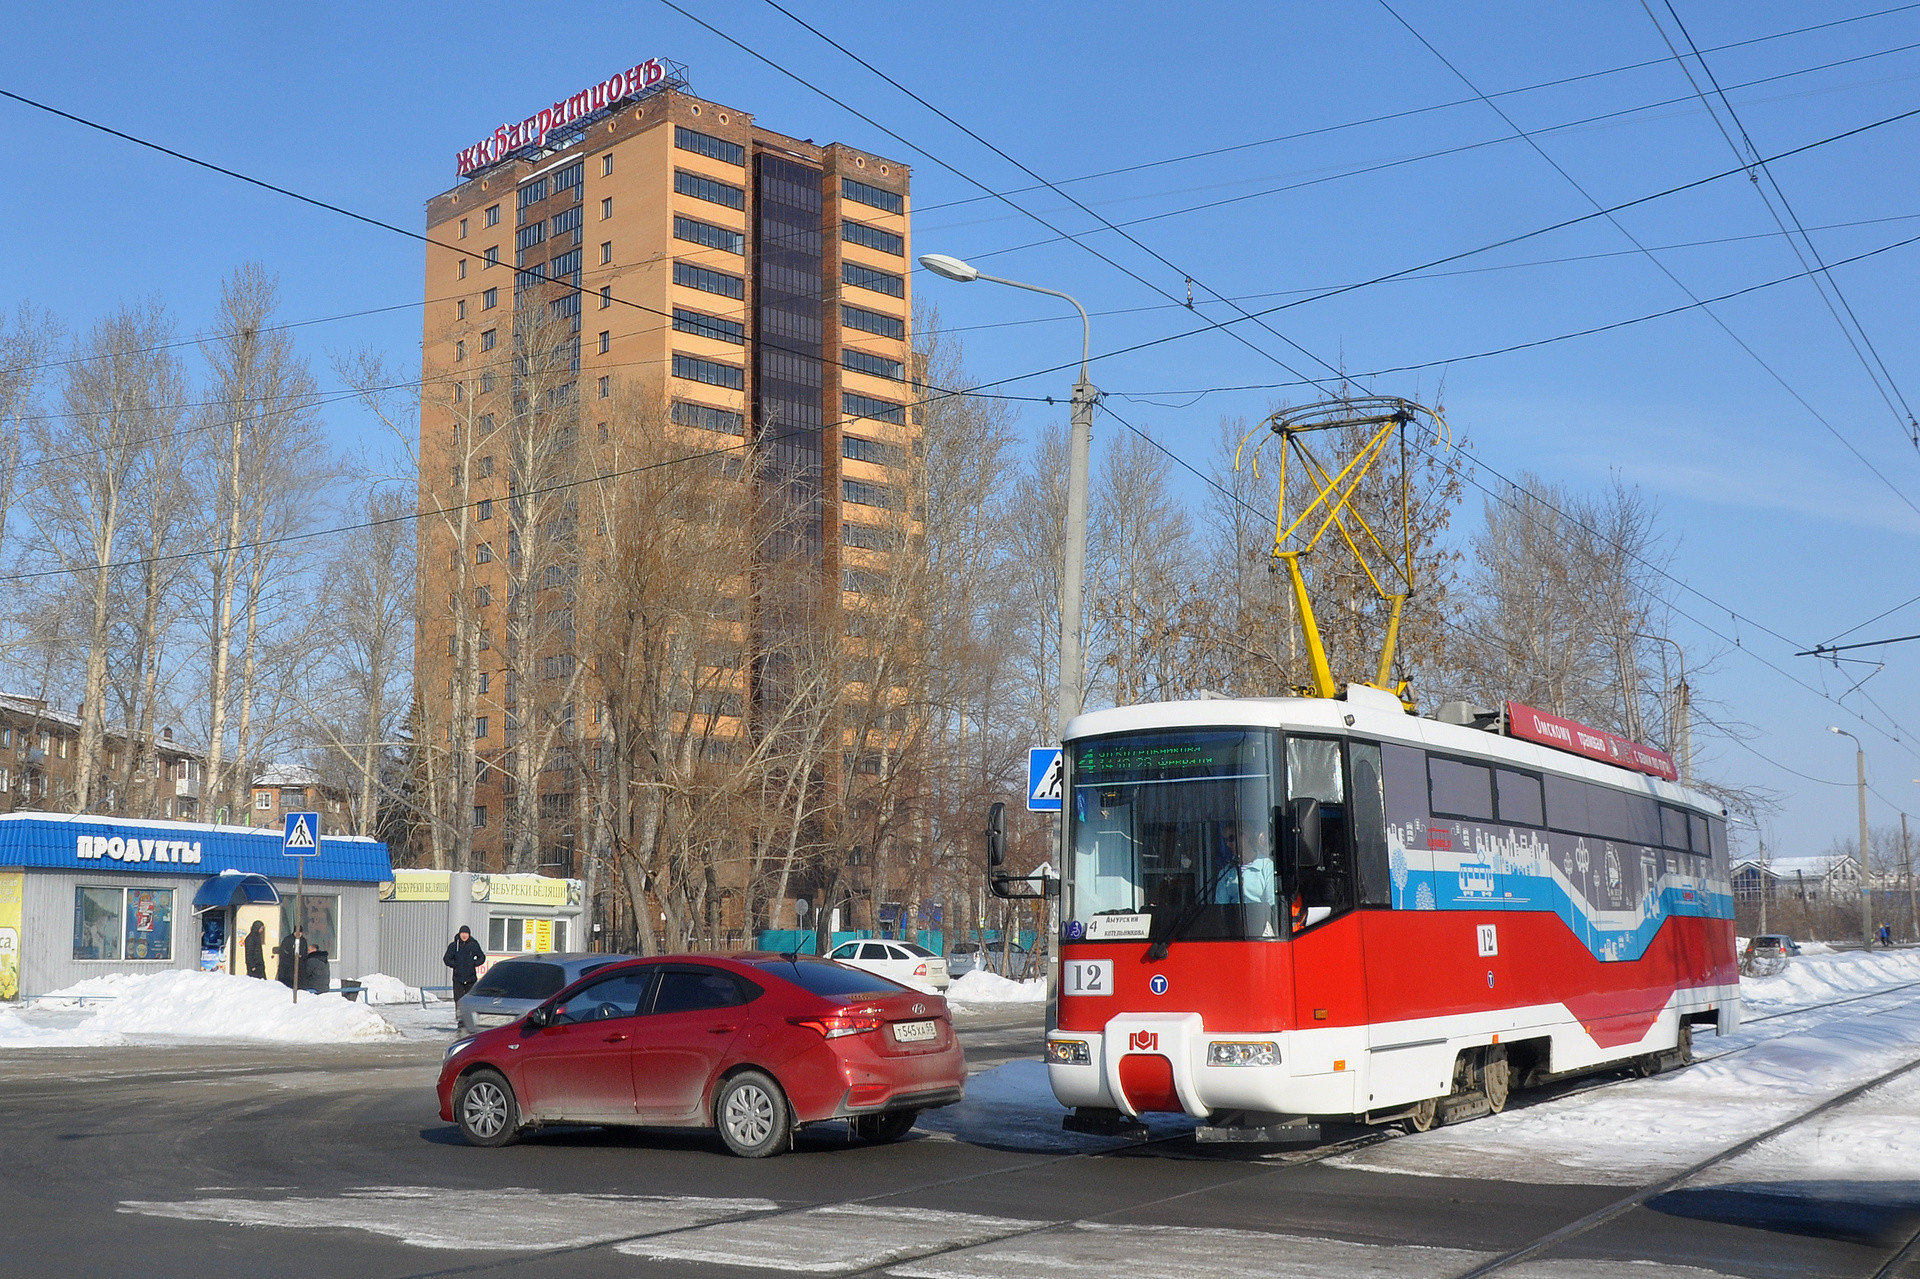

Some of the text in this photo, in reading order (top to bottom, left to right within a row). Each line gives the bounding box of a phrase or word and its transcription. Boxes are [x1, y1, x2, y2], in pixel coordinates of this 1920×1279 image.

[456, 136, 495, 176] ЖК
[76, 835, 202, 864] ПРОДУКТЫ
[396, 881, 425, 894] ЧЕБУРЕКИ
[489, 882, 567, 899] ЧЕБУРЕКИ БЕЛЯШИ
[1089, 920, 1098, 933] 4
[1482, 928, 1494, 952] 12
[1073, 964, 1102, 991] 12
